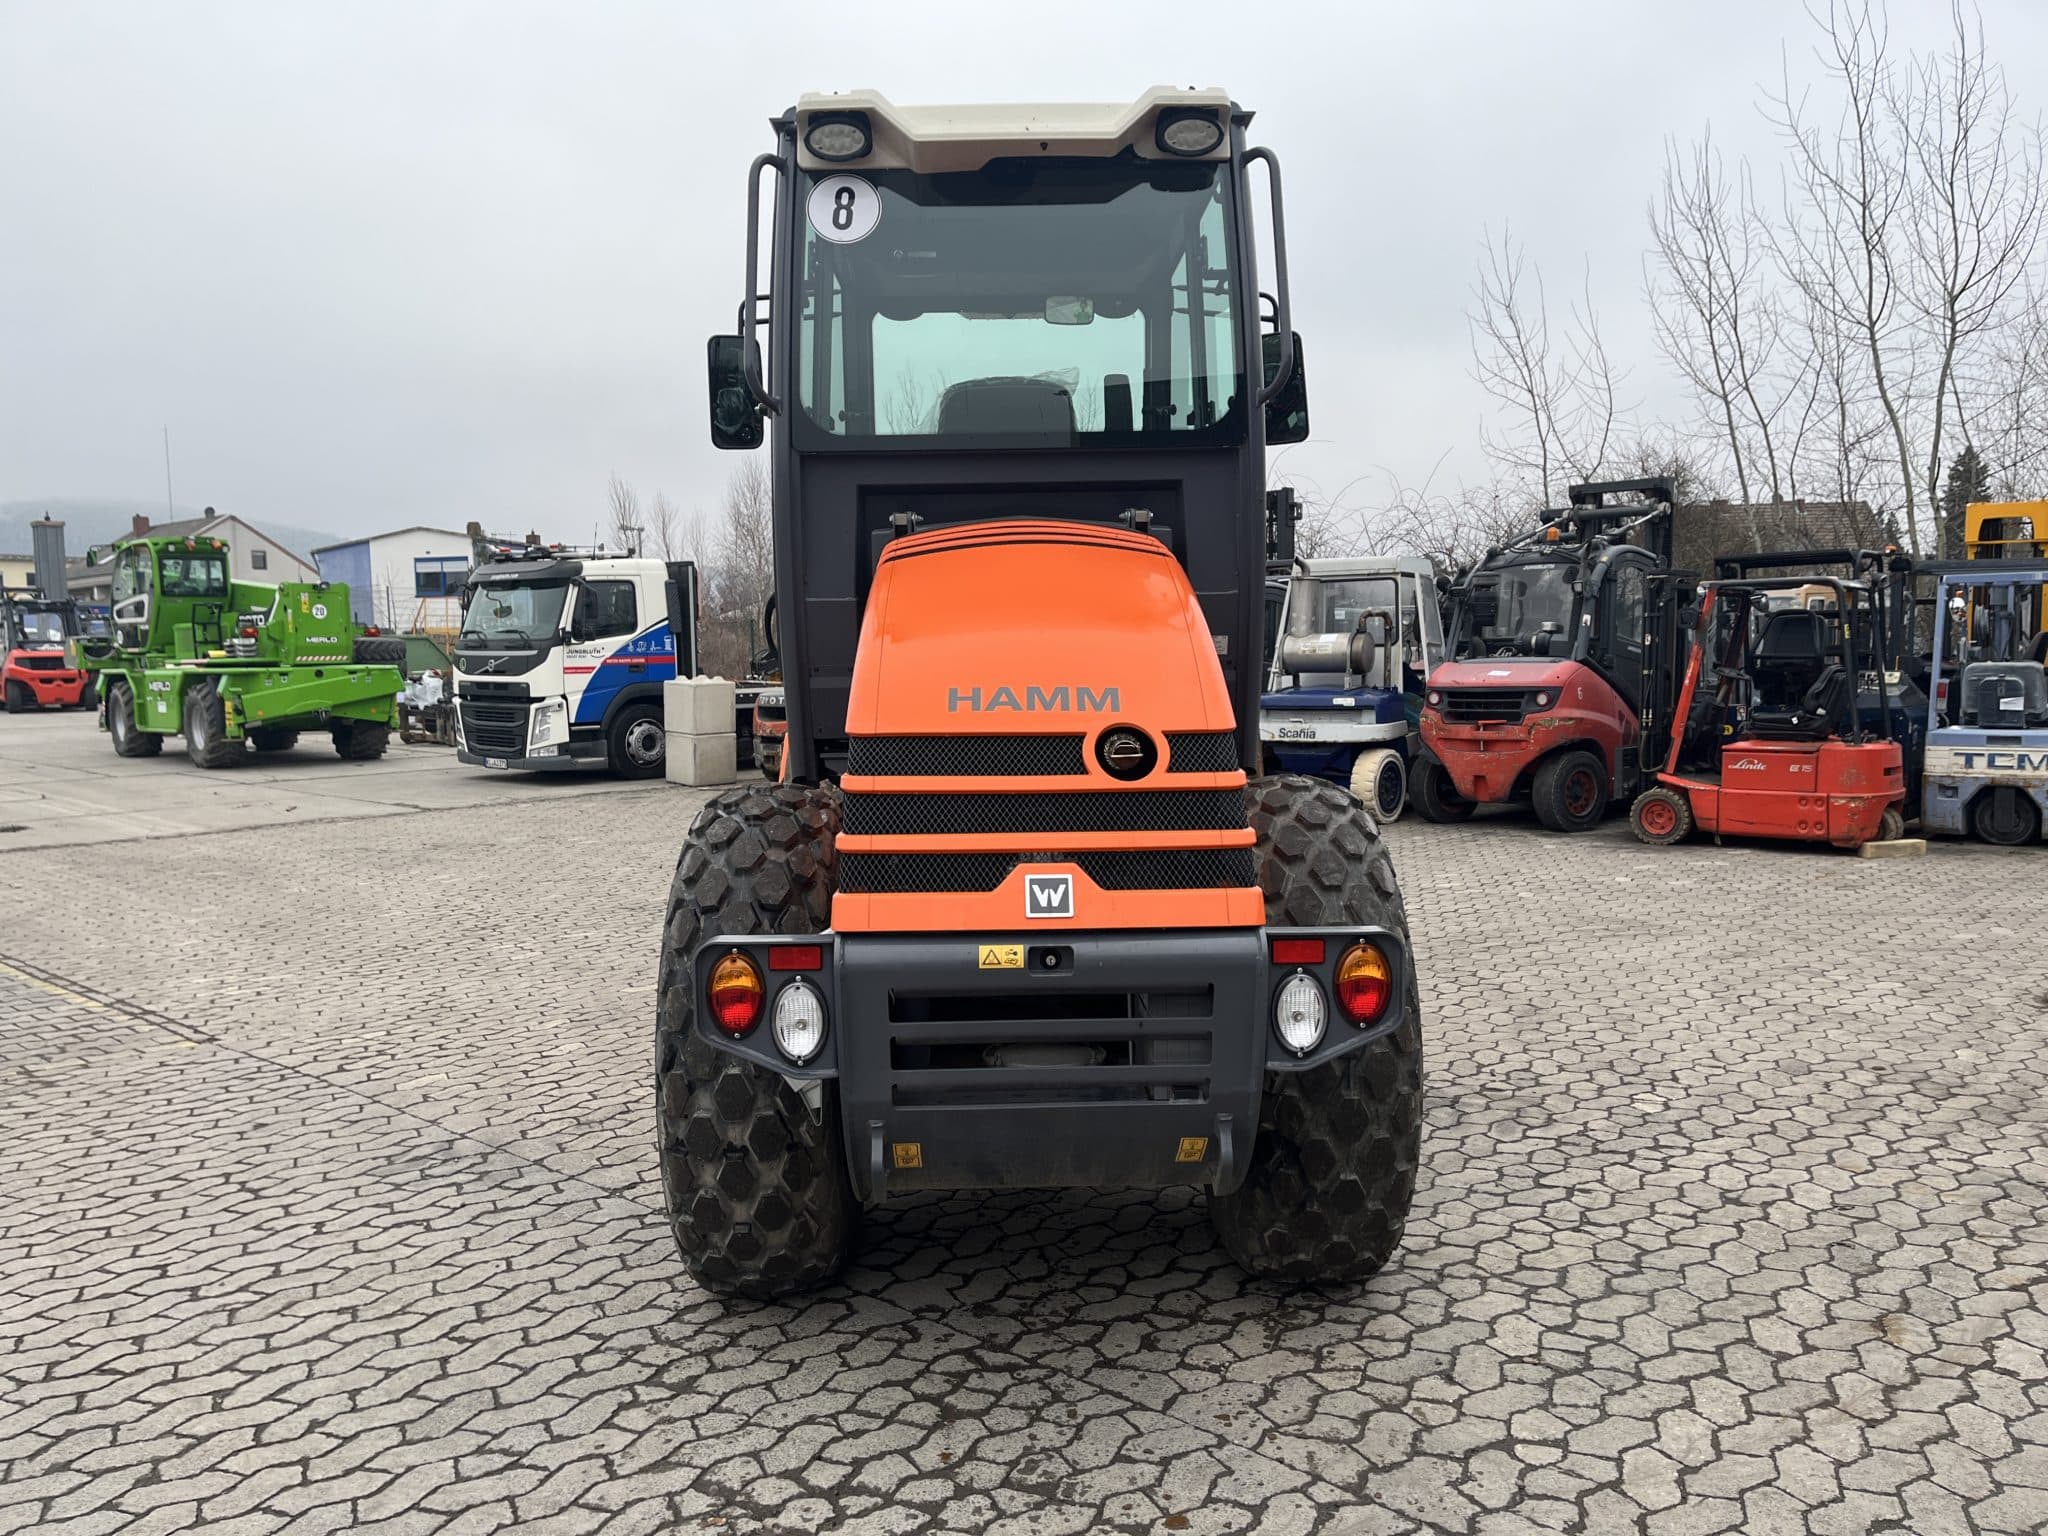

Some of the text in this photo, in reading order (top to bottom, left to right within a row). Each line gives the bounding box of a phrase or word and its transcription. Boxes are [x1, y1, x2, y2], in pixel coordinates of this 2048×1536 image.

[832, 186, 856, 231] 8
[947, 686, 1121, 713] HAMM
[1279, 727, 1316, 740] Scania
[1727, 758, 1767, 771] Linde
[1953, 752, 2048, 770] TCM
